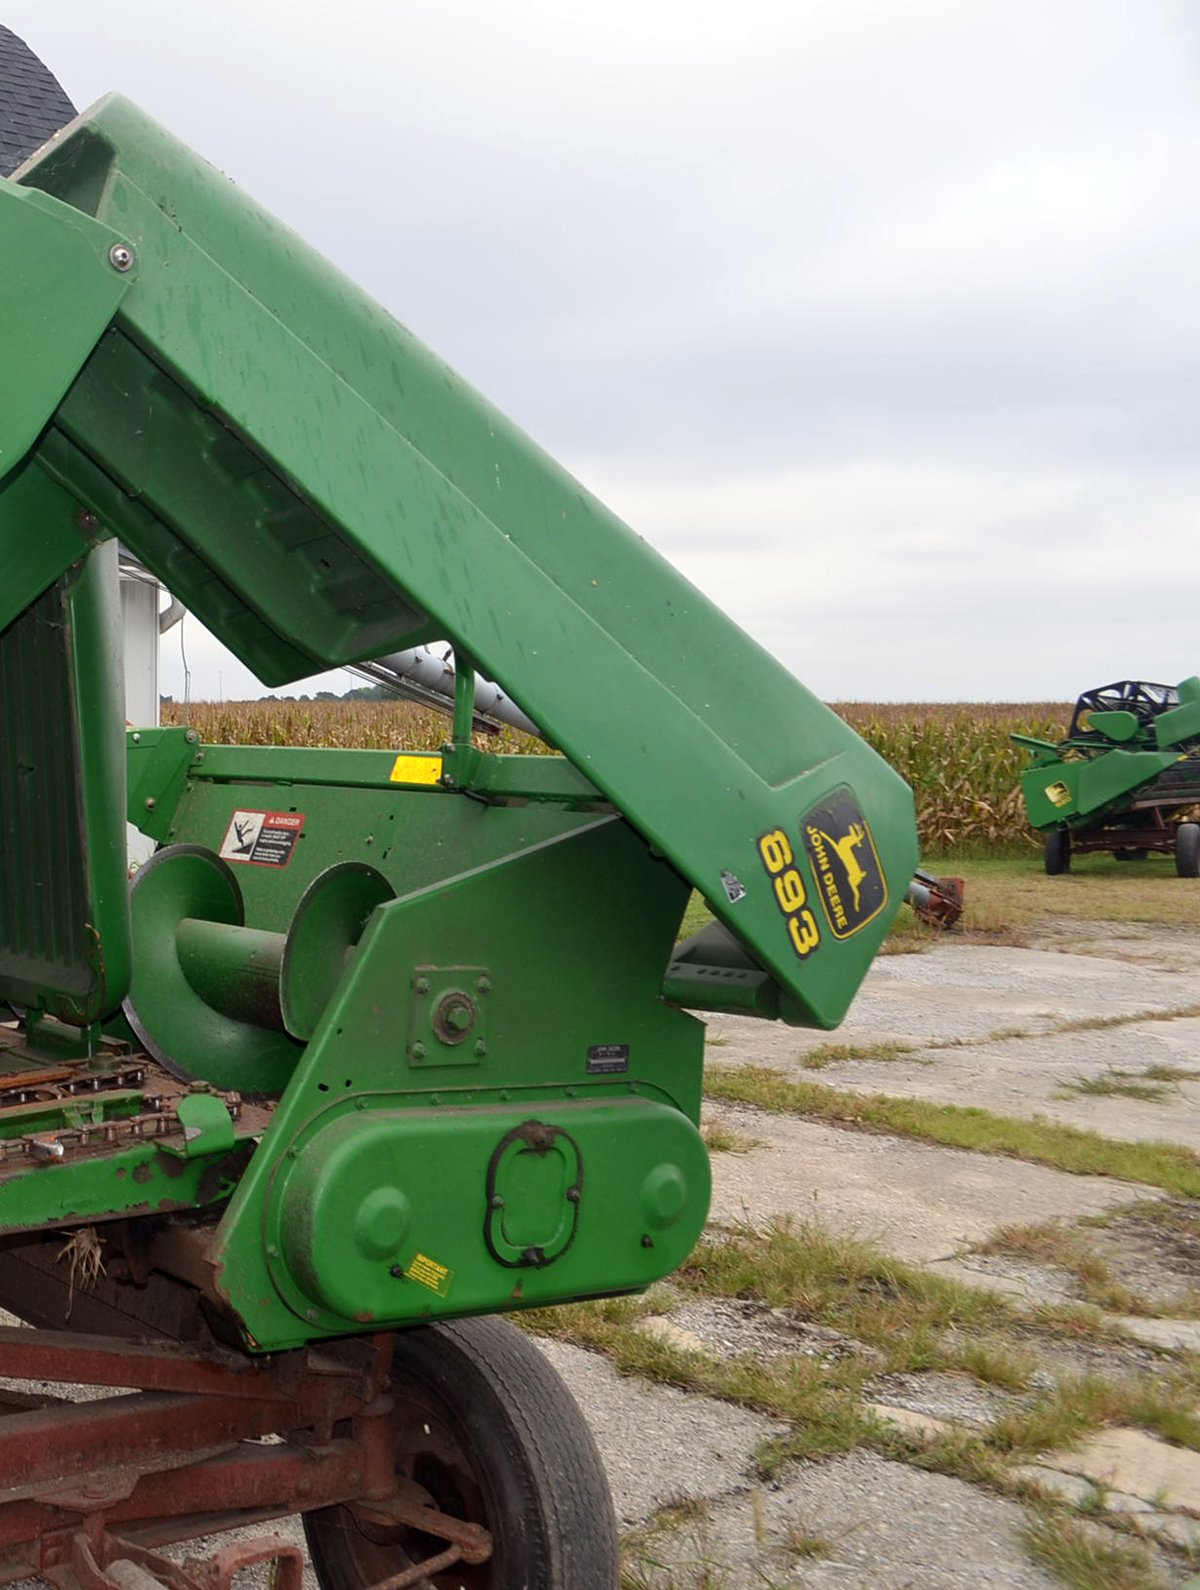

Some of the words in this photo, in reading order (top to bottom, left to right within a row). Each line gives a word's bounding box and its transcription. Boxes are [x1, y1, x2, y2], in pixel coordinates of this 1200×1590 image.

[275, 816, 300, 826] DANGER
[760, 830, 820, 955] 693
[806, 826, 830, 871] JOHN
[823, 872, 848, 929] DEERE
